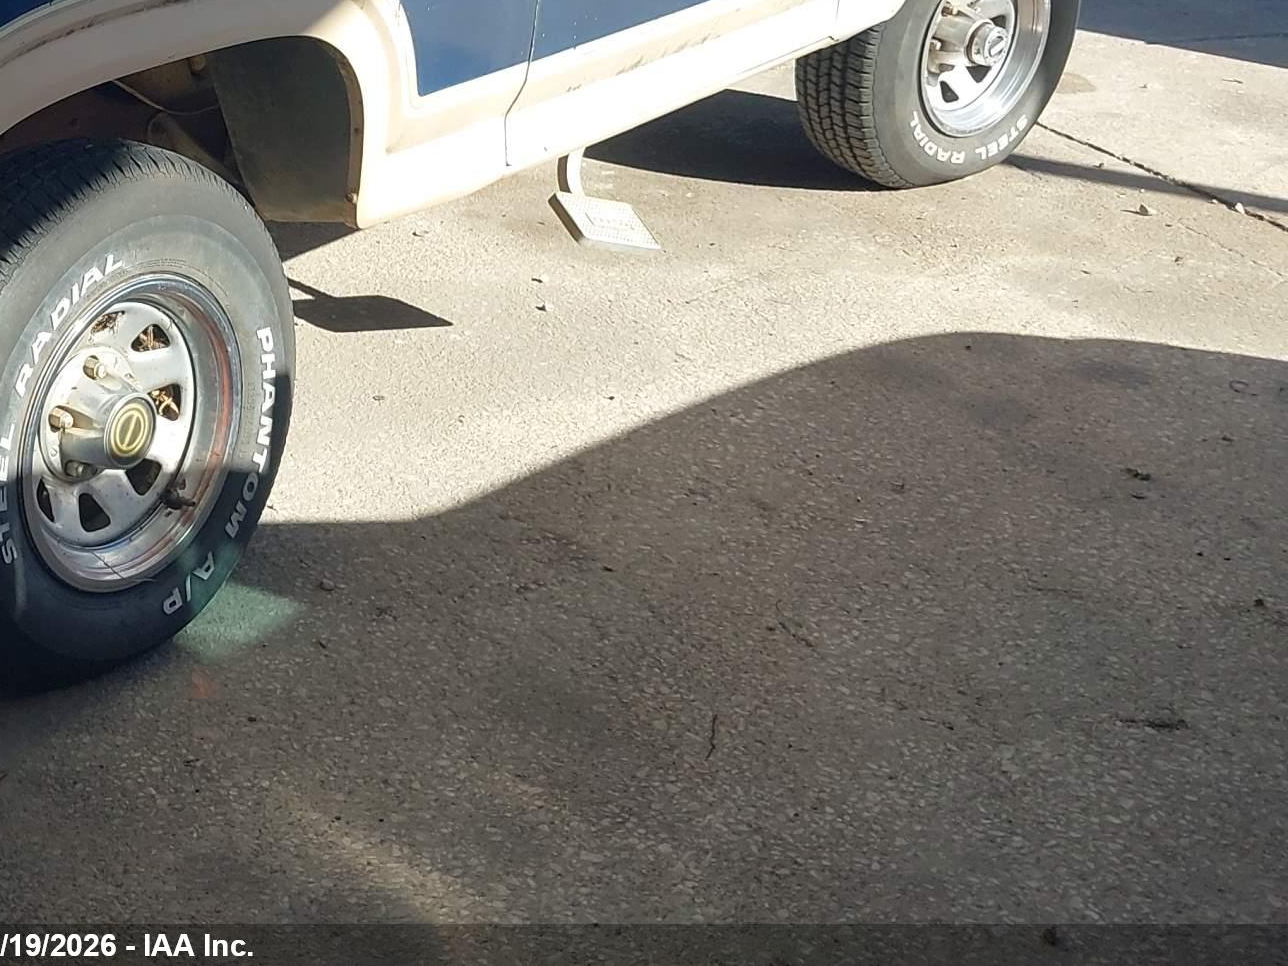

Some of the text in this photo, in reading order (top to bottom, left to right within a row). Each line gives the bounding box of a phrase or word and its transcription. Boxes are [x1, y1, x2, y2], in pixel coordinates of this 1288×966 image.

[907, 110, 1029, 164] STEEL RADIAL
[16, 253, 123, 399] RADIAL
[225, 327, 275, 539] PHANTOM
[162, 551, 216, 616] A/P
